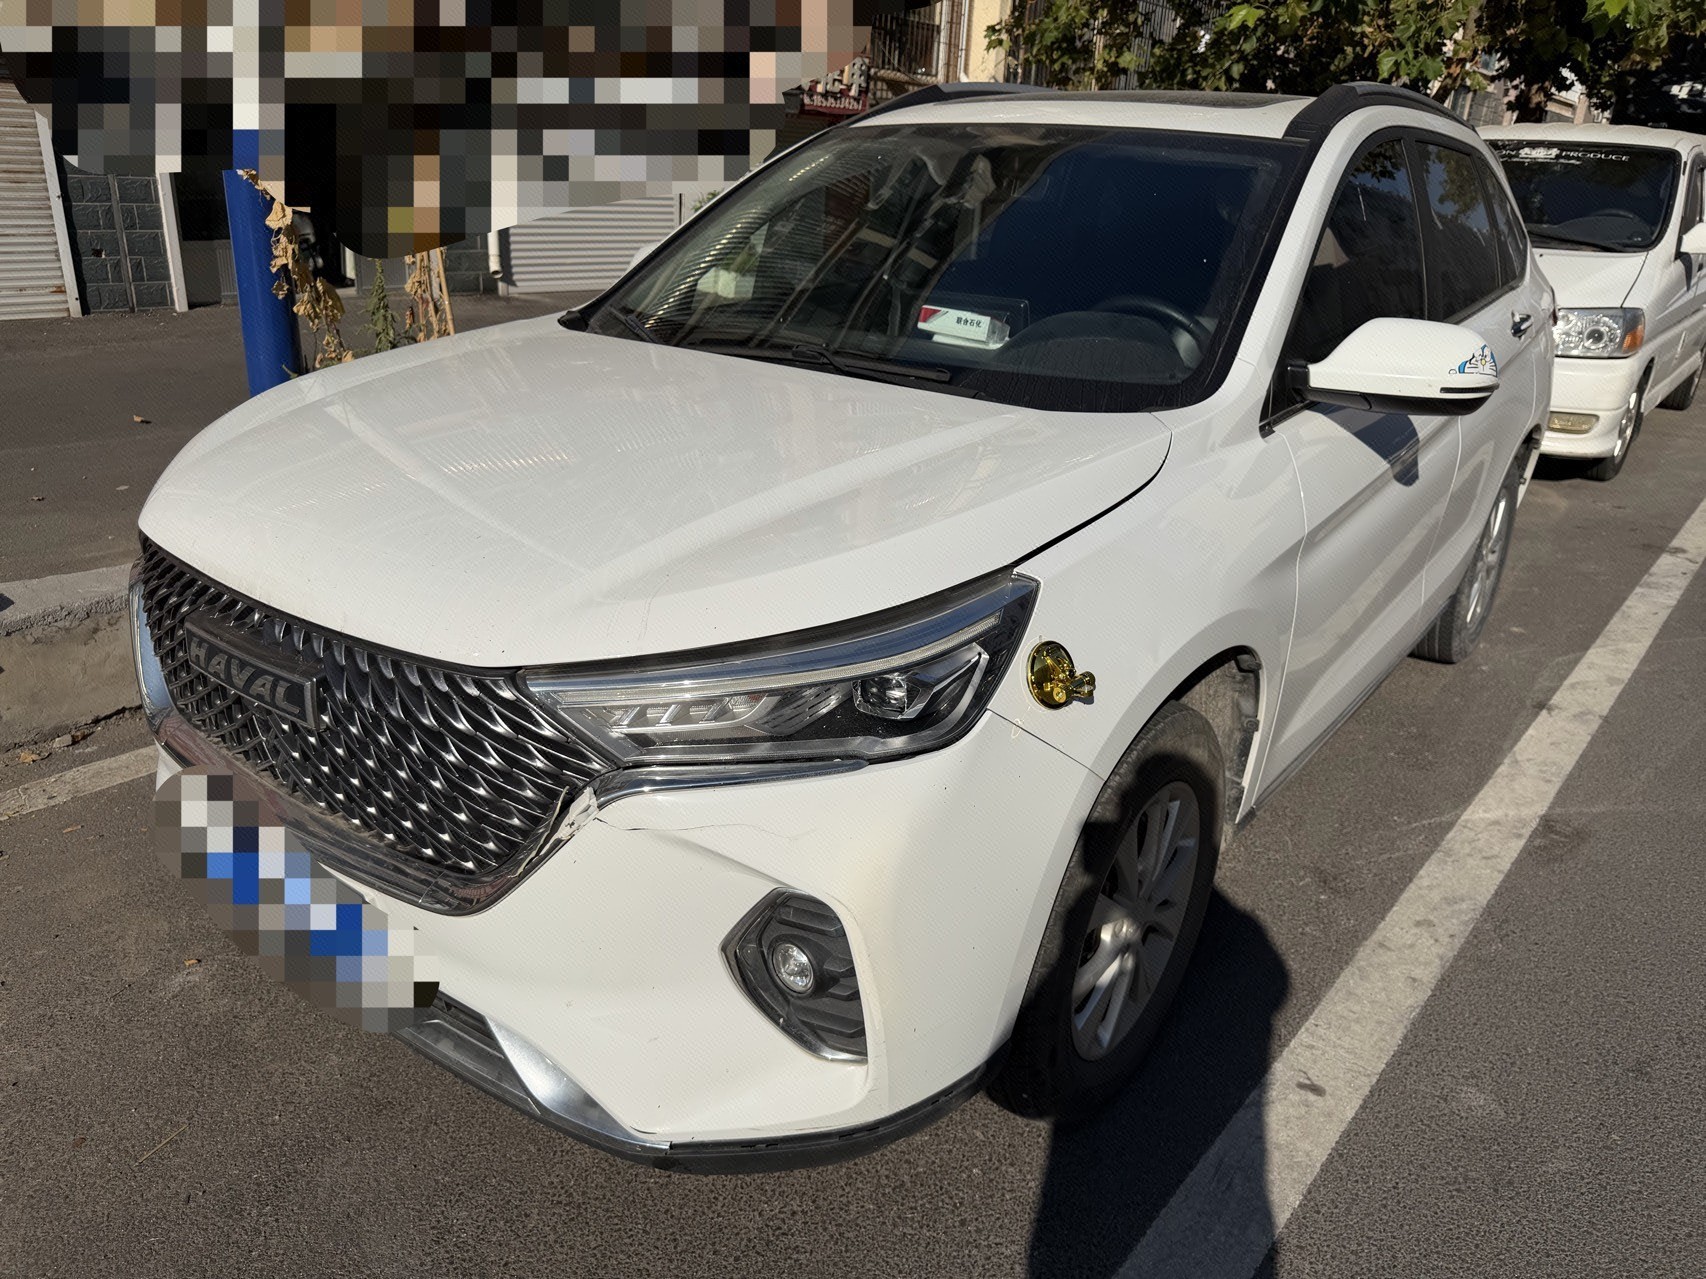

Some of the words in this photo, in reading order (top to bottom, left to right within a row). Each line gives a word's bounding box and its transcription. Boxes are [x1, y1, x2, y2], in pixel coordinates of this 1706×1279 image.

[1562, 151, 1631, 162] PRODUCE
[956, 316, 982, 328] 联合石化
[189, 638, 301, 715] HAVAL
